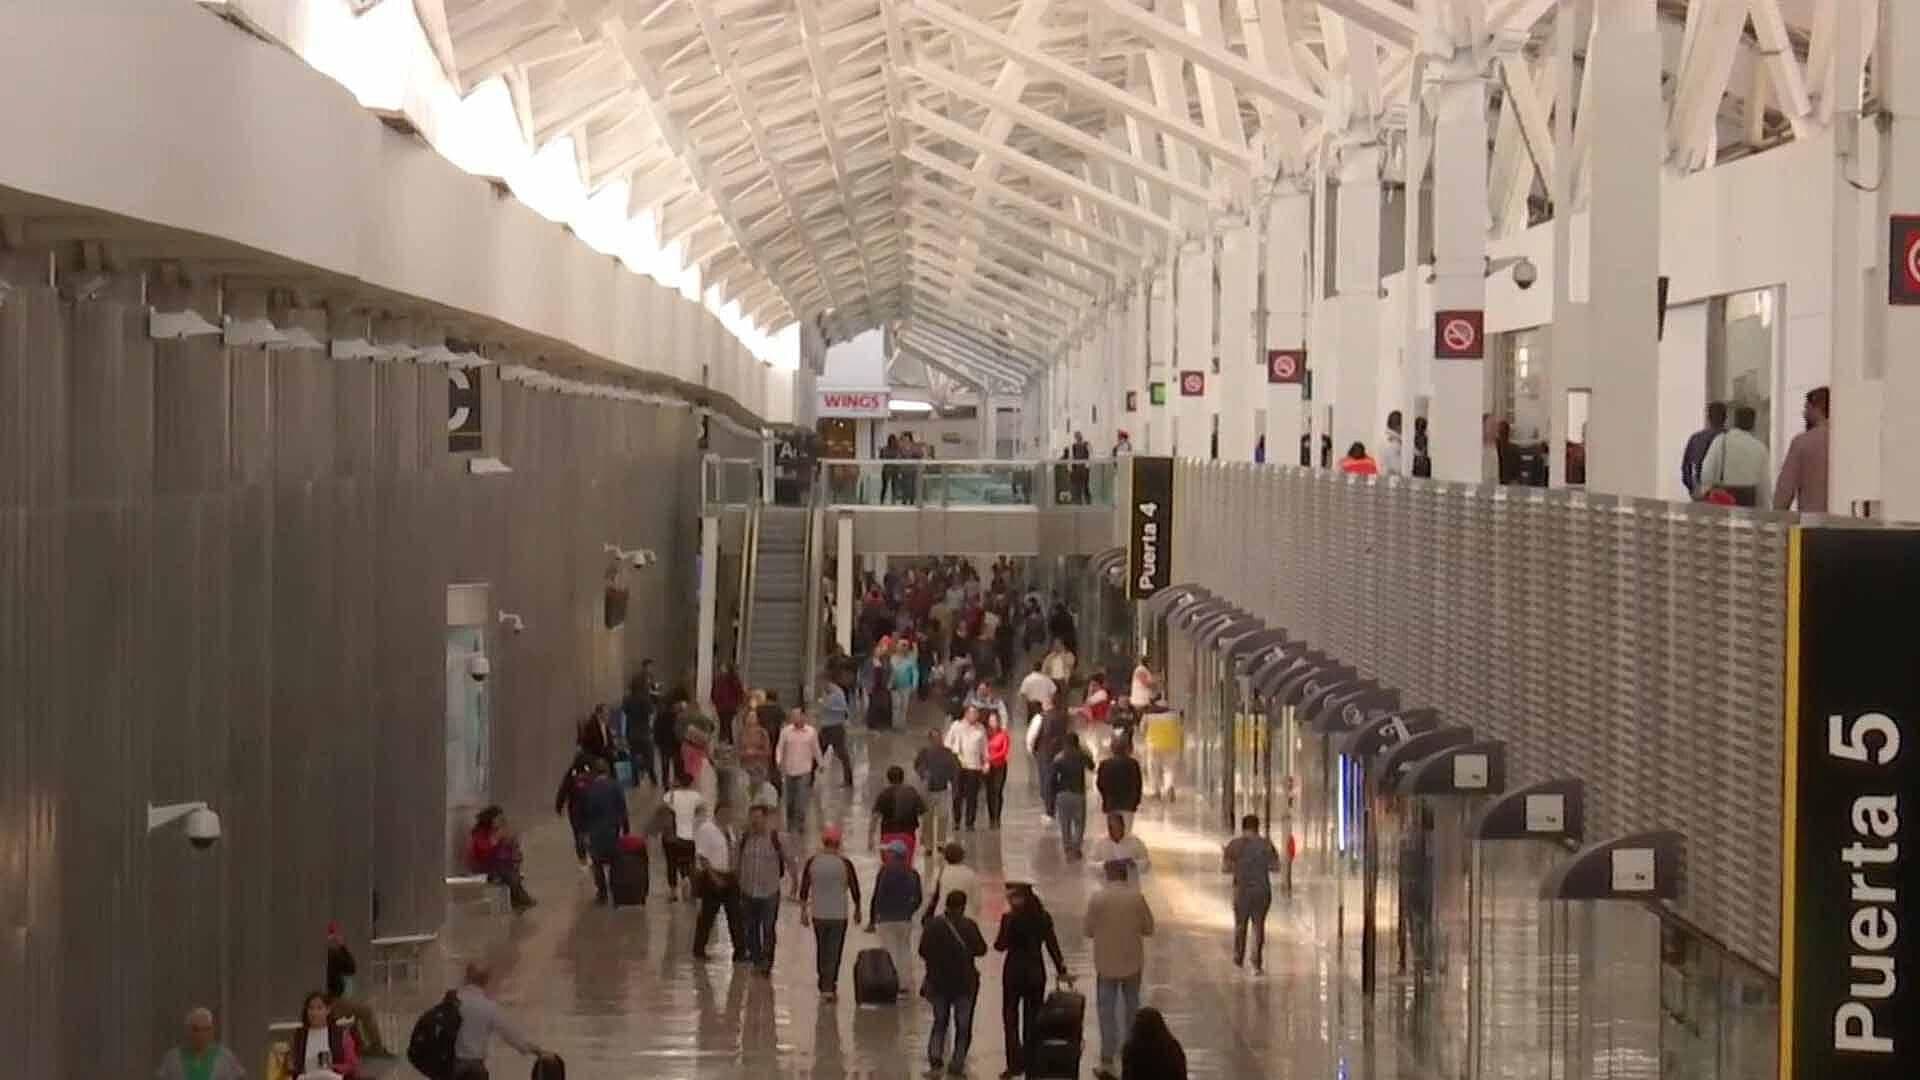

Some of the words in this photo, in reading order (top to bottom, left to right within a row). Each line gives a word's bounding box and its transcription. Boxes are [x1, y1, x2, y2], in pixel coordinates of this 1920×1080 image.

[824, 393, 879, 409] WINGS
[1139, 502, 1158, 517] 4
[1138, 523, 1157, 590] Puerta
[1828, 711, 1901, 765] 5
[1834, 794, 1898, 1053] Puerta
